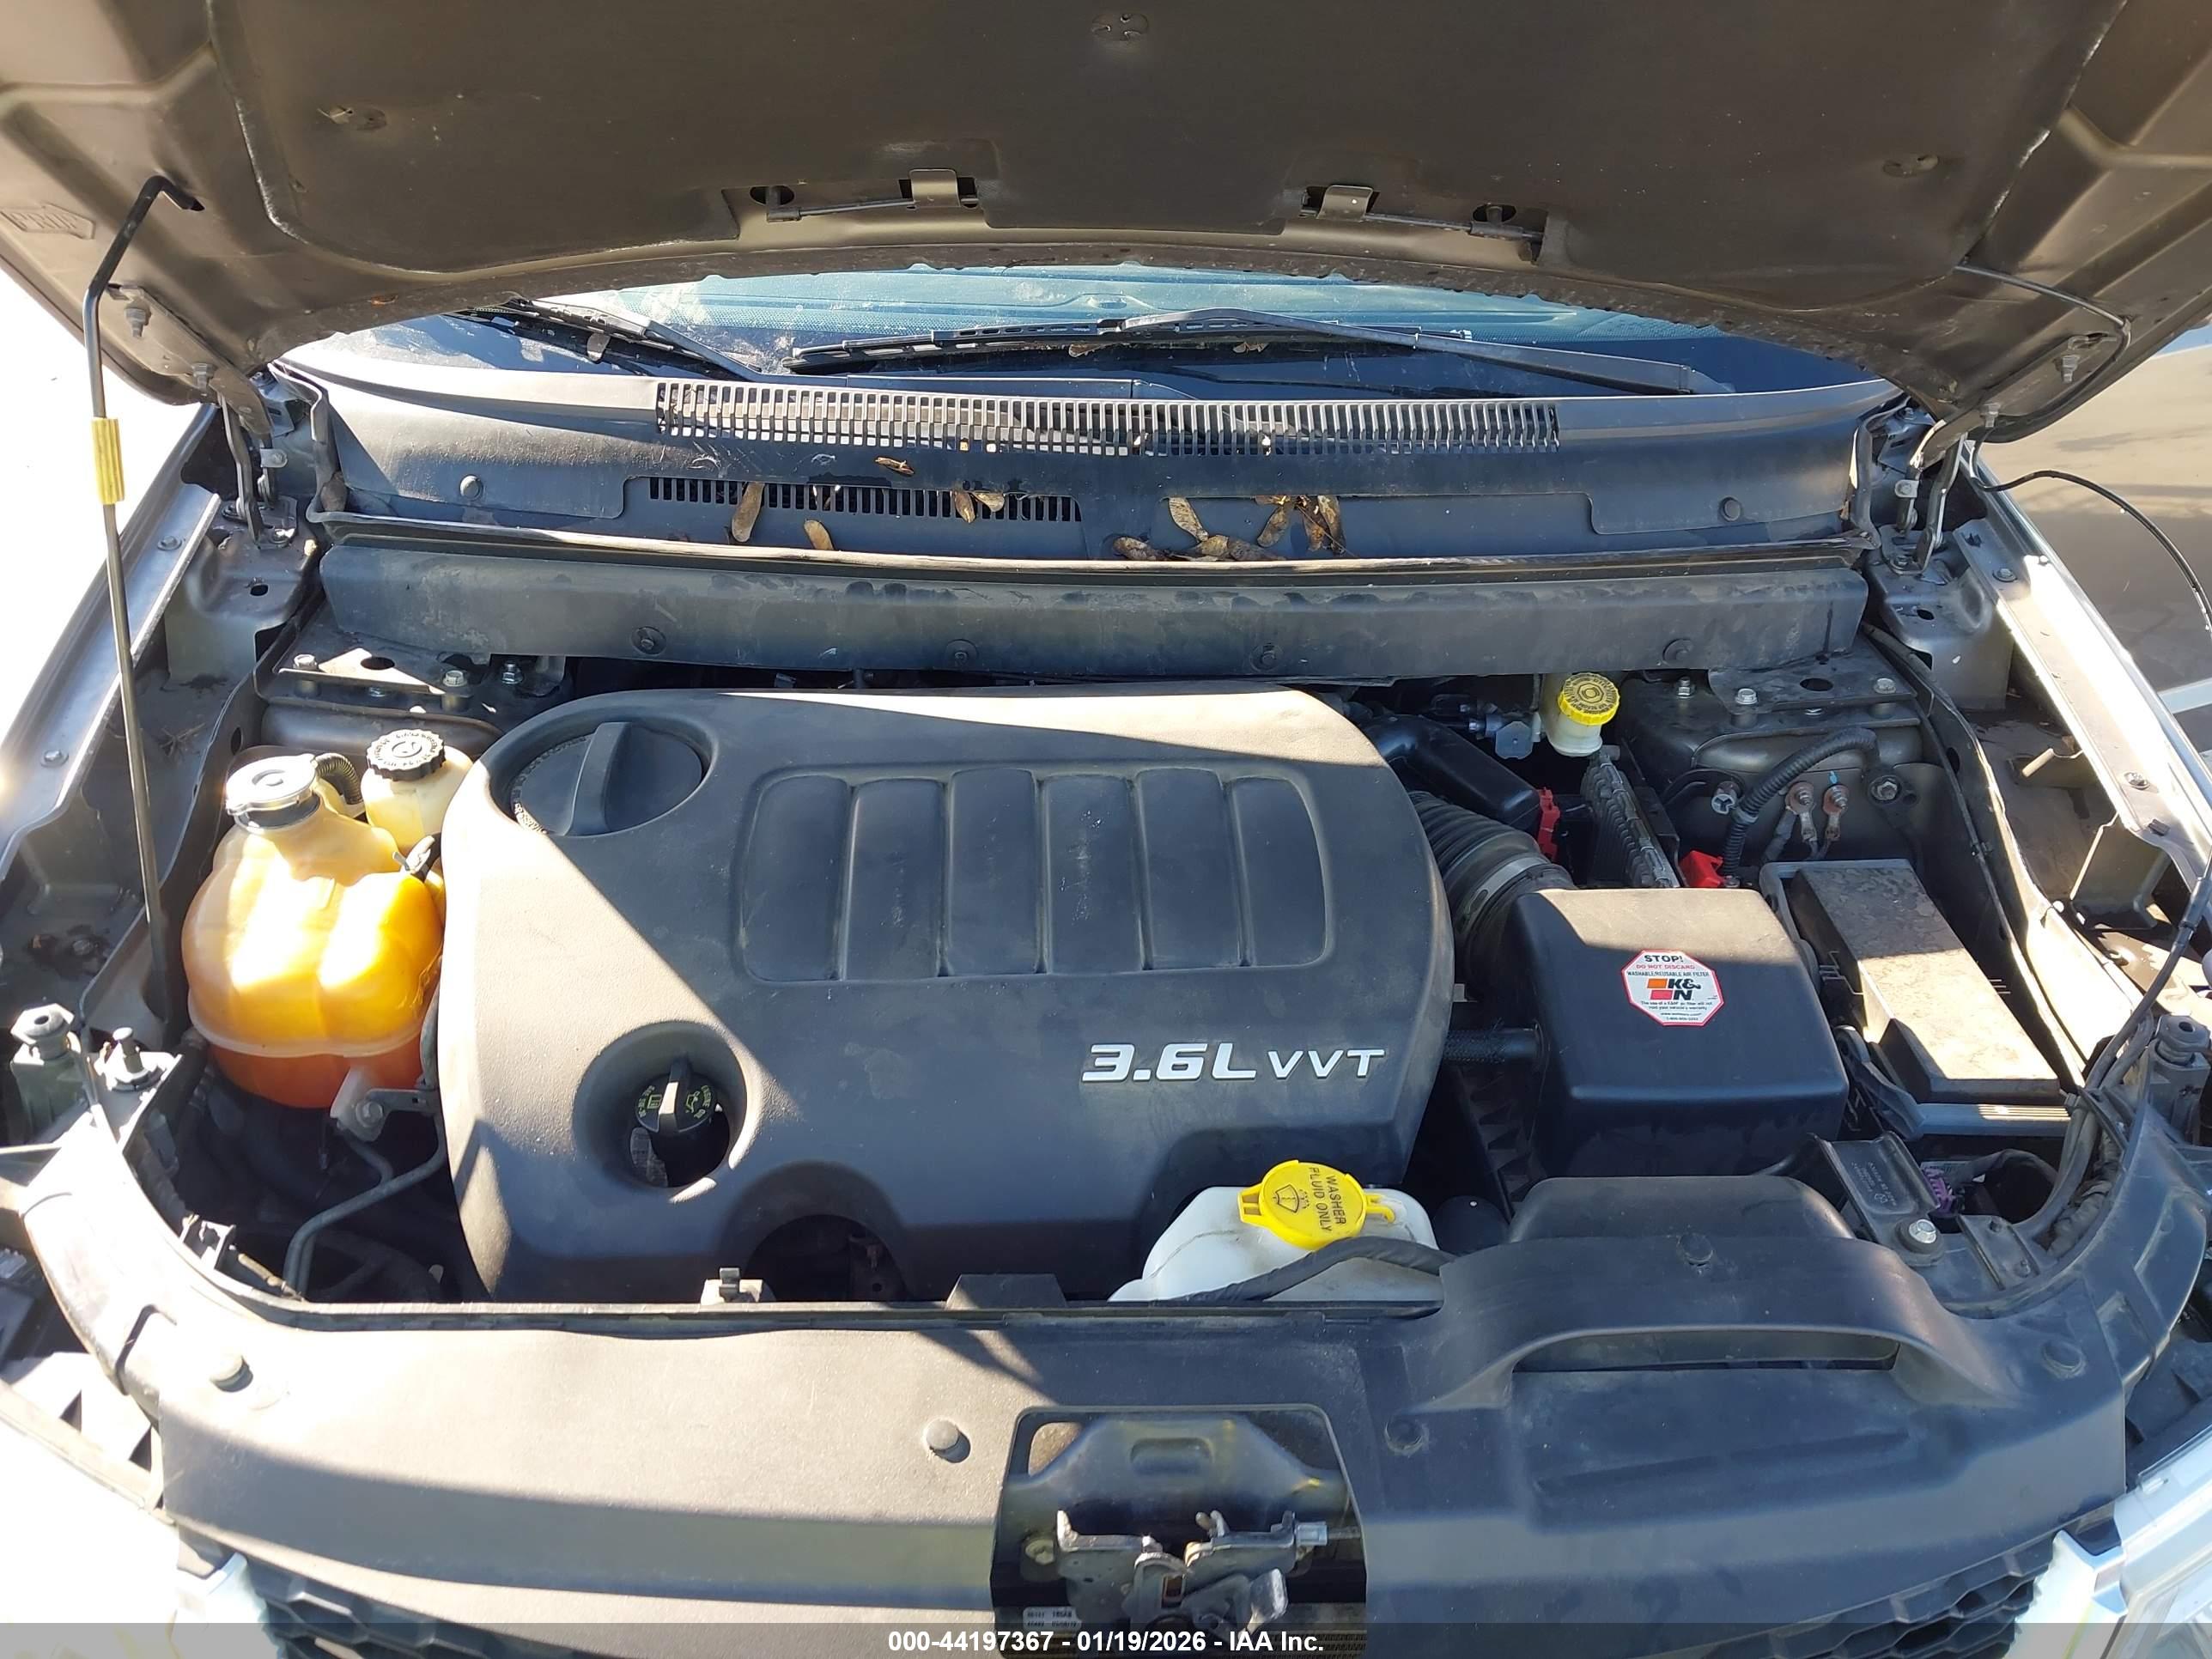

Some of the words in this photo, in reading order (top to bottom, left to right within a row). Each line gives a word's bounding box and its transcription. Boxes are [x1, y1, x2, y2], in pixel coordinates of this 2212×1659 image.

[1081, 1042, 1257, 1082] 3.6L
[1267, 1049, 1385, 1079] VVT
[1309, 1168, 1325, 1200] FLUID
[1325, 1175, 1346, 1224] WASHER
[1316, 1201, 1333, 1232] ONLY
